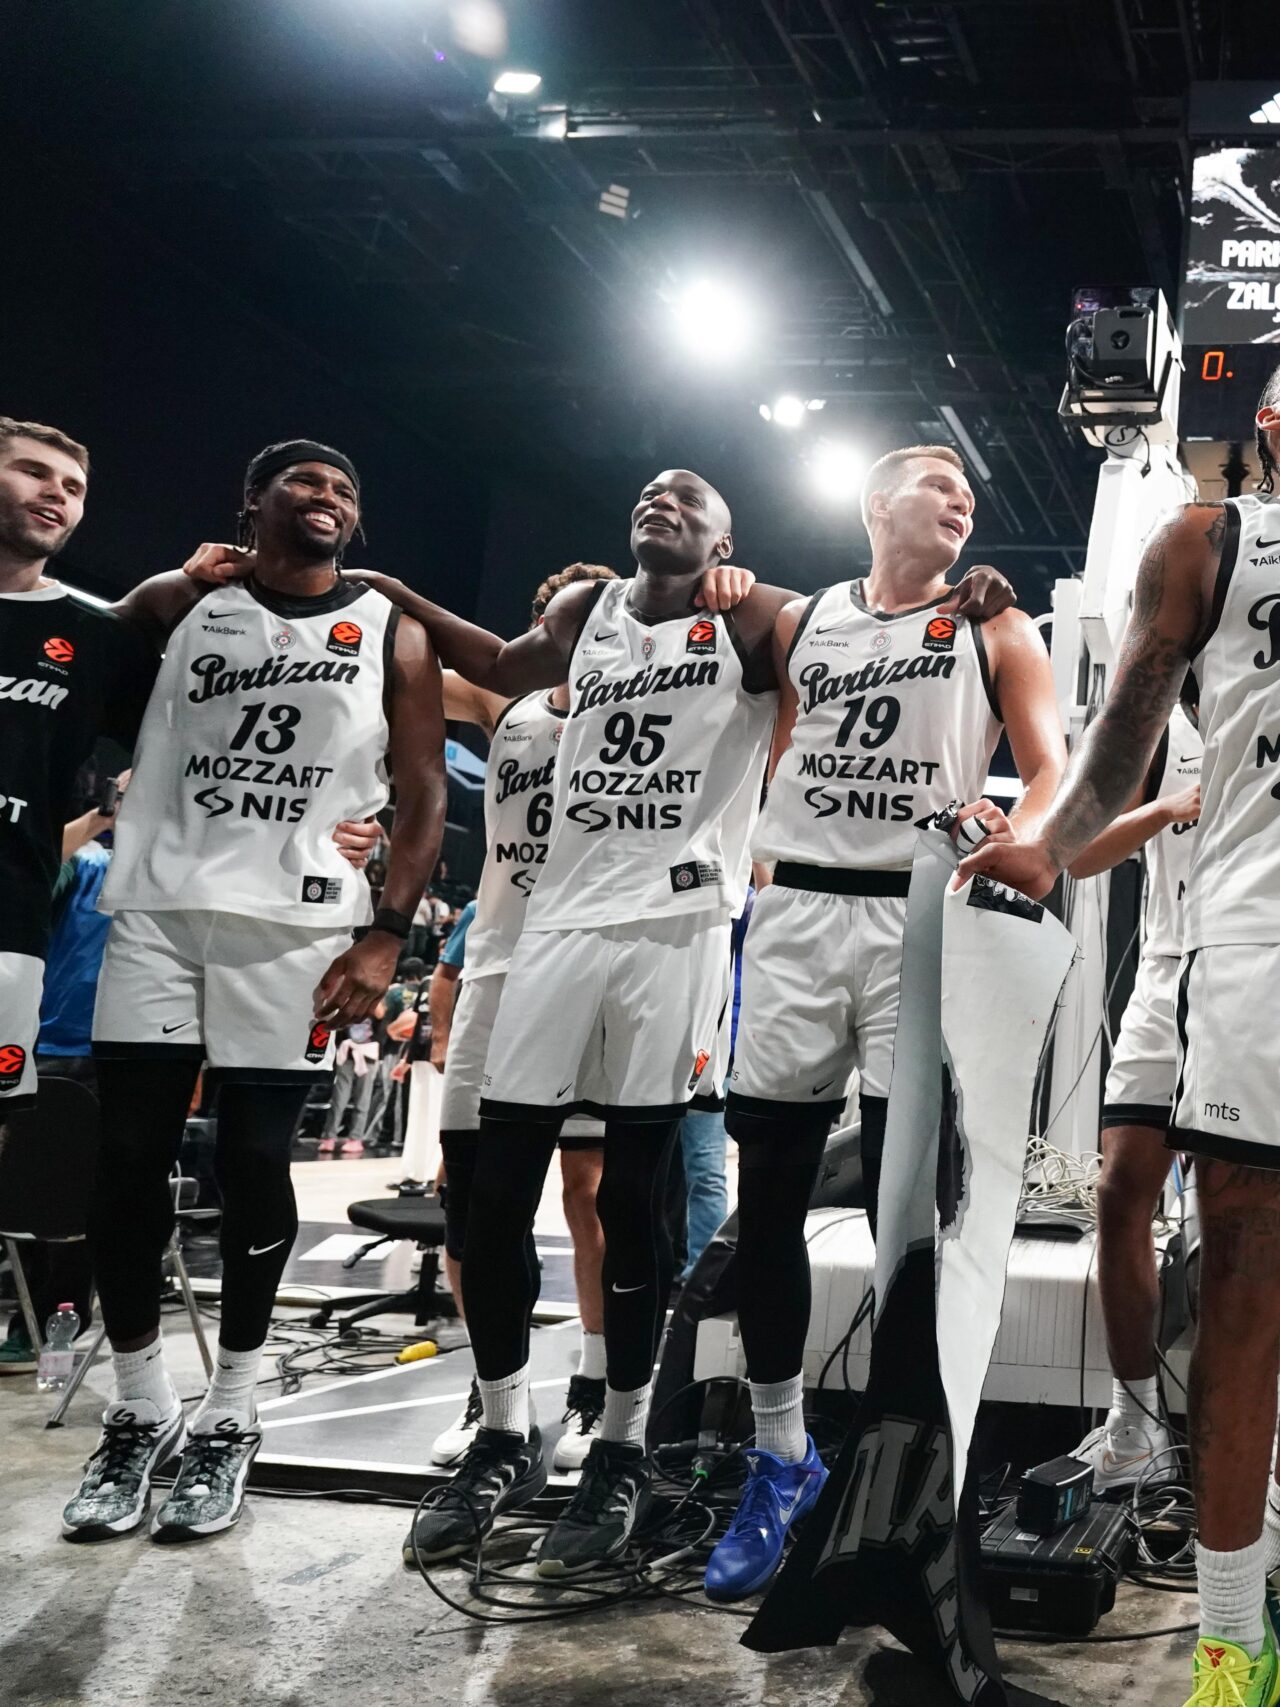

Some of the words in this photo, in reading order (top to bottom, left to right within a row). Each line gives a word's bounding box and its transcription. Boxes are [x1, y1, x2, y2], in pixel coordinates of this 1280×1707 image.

[188, 653, 360, 704] Partizan
[573, 658, 720, 718] Partizan
[799, 652, 956, 715] Partizan
[229, 701, 302, 755] 13
[599, 711, 673, 767] 95
[835, 695, 901, 750] 19
[184, 755, 334, 788] MOZZART
[496, 755, 556, 805] Part
[569, 769, 702, 796] MOZZART
[797, 753, 940, 785] MOZZART
[240, 793, 308, 823] NIS
[618, 804, 682, 830] NIS
[847, 790, 914, 822] NIS
[1204, 1101, 1241, 1122] mts
